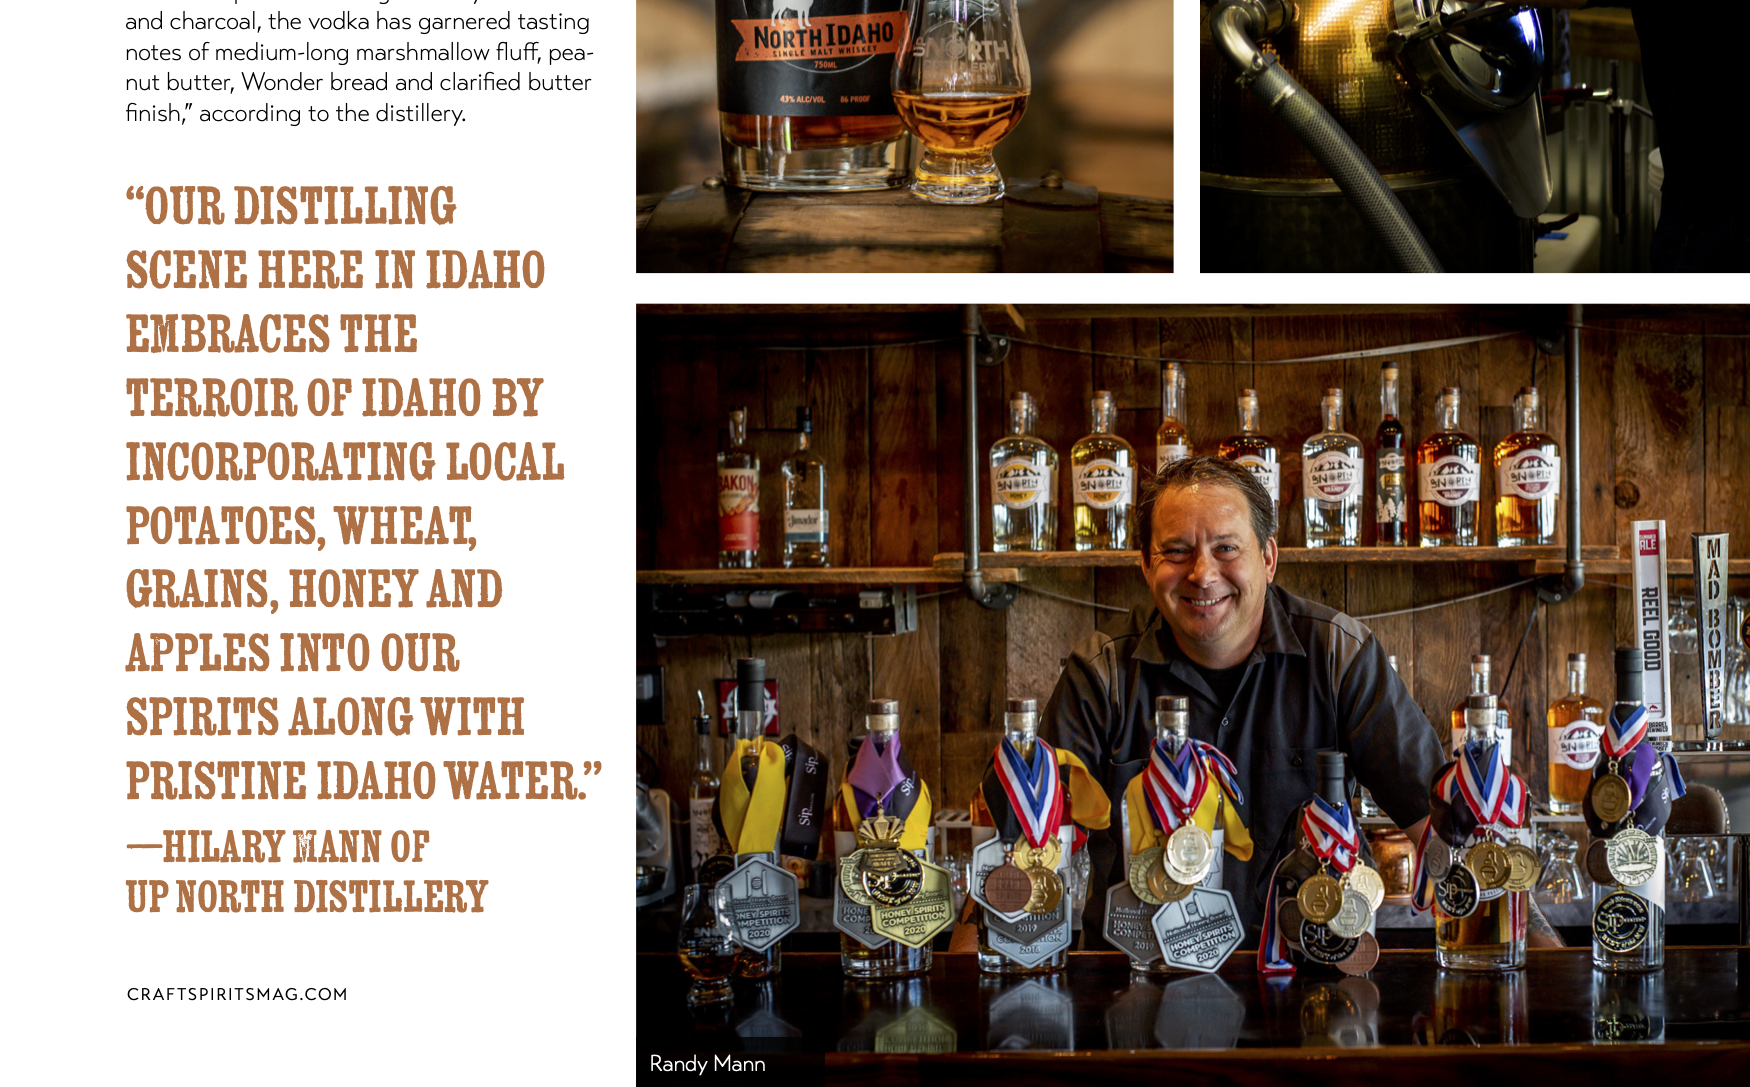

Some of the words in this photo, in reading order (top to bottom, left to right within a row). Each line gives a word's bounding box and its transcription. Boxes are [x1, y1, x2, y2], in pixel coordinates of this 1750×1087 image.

[772, 48, 805, 58] SINGLE
[810, 47, 834, 56] MALT
[838, 44, 878, 54] WHISKEY
[814, 60, 838, 69] 750ML
[199, 102, 301, 127] according
[307, 105, 330, 122] to
[335, 102, 370, 123] the
[375, 102, 466, 127] distillery.
[780, 94, 796, 104] 43%
[796, 94, 826, 104] ALC/VOL
[840, 94, 849, 104] 86
[850, 94, 871, 104] PROOF
[233, 185, 458, 226] DISTILLING
[125, 249, 248, 290] SCENE
[257, 249, 364, 290] HERE
[374, 249, 416, 290] IN
[425, 249, 546, 290] IDAHO
[125, 313, 331, 354] EMBRACES
[339, 313, 418, 353] THE
[125, 377, 299, 418] TERROIR
[306, 377, 353, 417] OF
[361, 377, 482, 418] IDAHO
[491, 377, 545, 418] BY
[125, 441, 437, 482] INCORPORATING
[445, 441, 566, 482] LOCAL
[125, 505, 326, 552] POTATOES,
[332, 505, 477, 552] WHEAT,
[1639, 539, 1656, 550] ALE
[1706, 538, 1721, 600] MAD
[126, 568, 279, 615] GRAINS,
[288, 568, 420, 609] HONEY
[425, 568, 504, 609] AND
[1641, 586, 1660, 626] REEL
[124, 632, 271, 673] APPLES
[279, 632, 371, 673] INTO
[380, 632, 461, 673] OUR
[1643, 629, 1662, 671] GOOD
[1707, 608, 1722, 730] BOMBER
[125, 696, 280, 737] SPIRITS
[287, 696, 415, 737] ALONG
[419, 696, 525, 737] WITH
[125, 760, 307, 801] PRISTINE
[316, 760, 437, 801] IDAHO
[292, 829, 383, 864] MANN
[390, 829, 430, 863] OF
[125, 879, 170, 913] UP
[175, 879, 285, 914] NORTH
[293, 879, 490, 914] DISTILLERY
[881, 907, 914, 919] HONEY
[914, 903, 945, 915] SPIRITS
[759, 907, 790, 918] SPIRITS
[882, 911, 946, 927] COMPETITION
[1016, 923, 1037, 933] 2019
[748, 929, 770, 938] 2020
[904, 925, 926, 935] 2020
[1170, 935, 1201, 951] HONEY
[1202, 923, 1233, 940] SPIRITS
[1173, 931, 1236, 958] COMPETITION
[1134, 941, 1155, 951] 2019
[1197, 948, 1219, 962] 2020
[126, 987, 347, 1001] CRAFTSPIRITSMAG.COM
